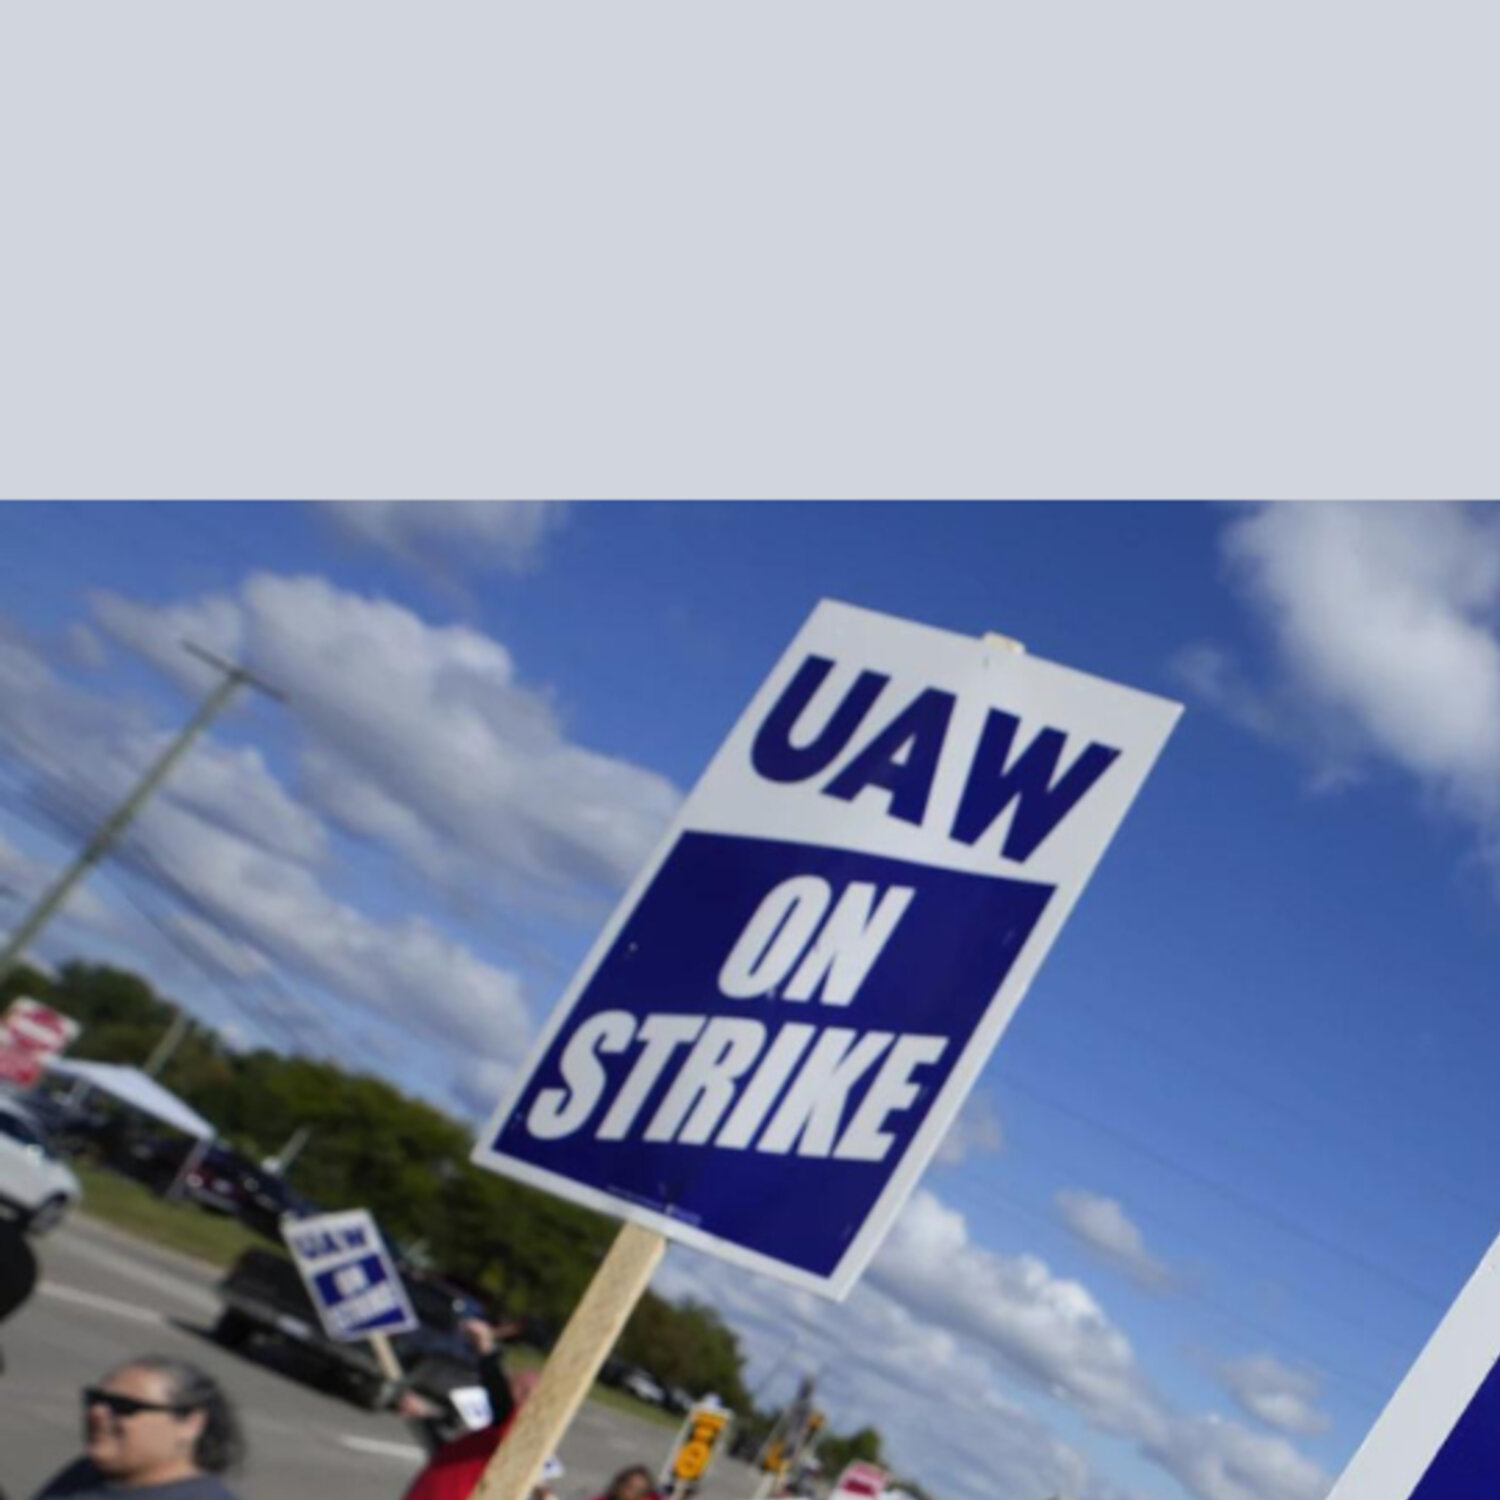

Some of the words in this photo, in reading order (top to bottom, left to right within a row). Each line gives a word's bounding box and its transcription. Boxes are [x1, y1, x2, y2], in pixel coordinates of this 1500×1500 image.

[750, 654, 1122, 863] UAW
[717, 875, 915, 1005] ON
[526, 1010, 948, 1161] STRIKE
